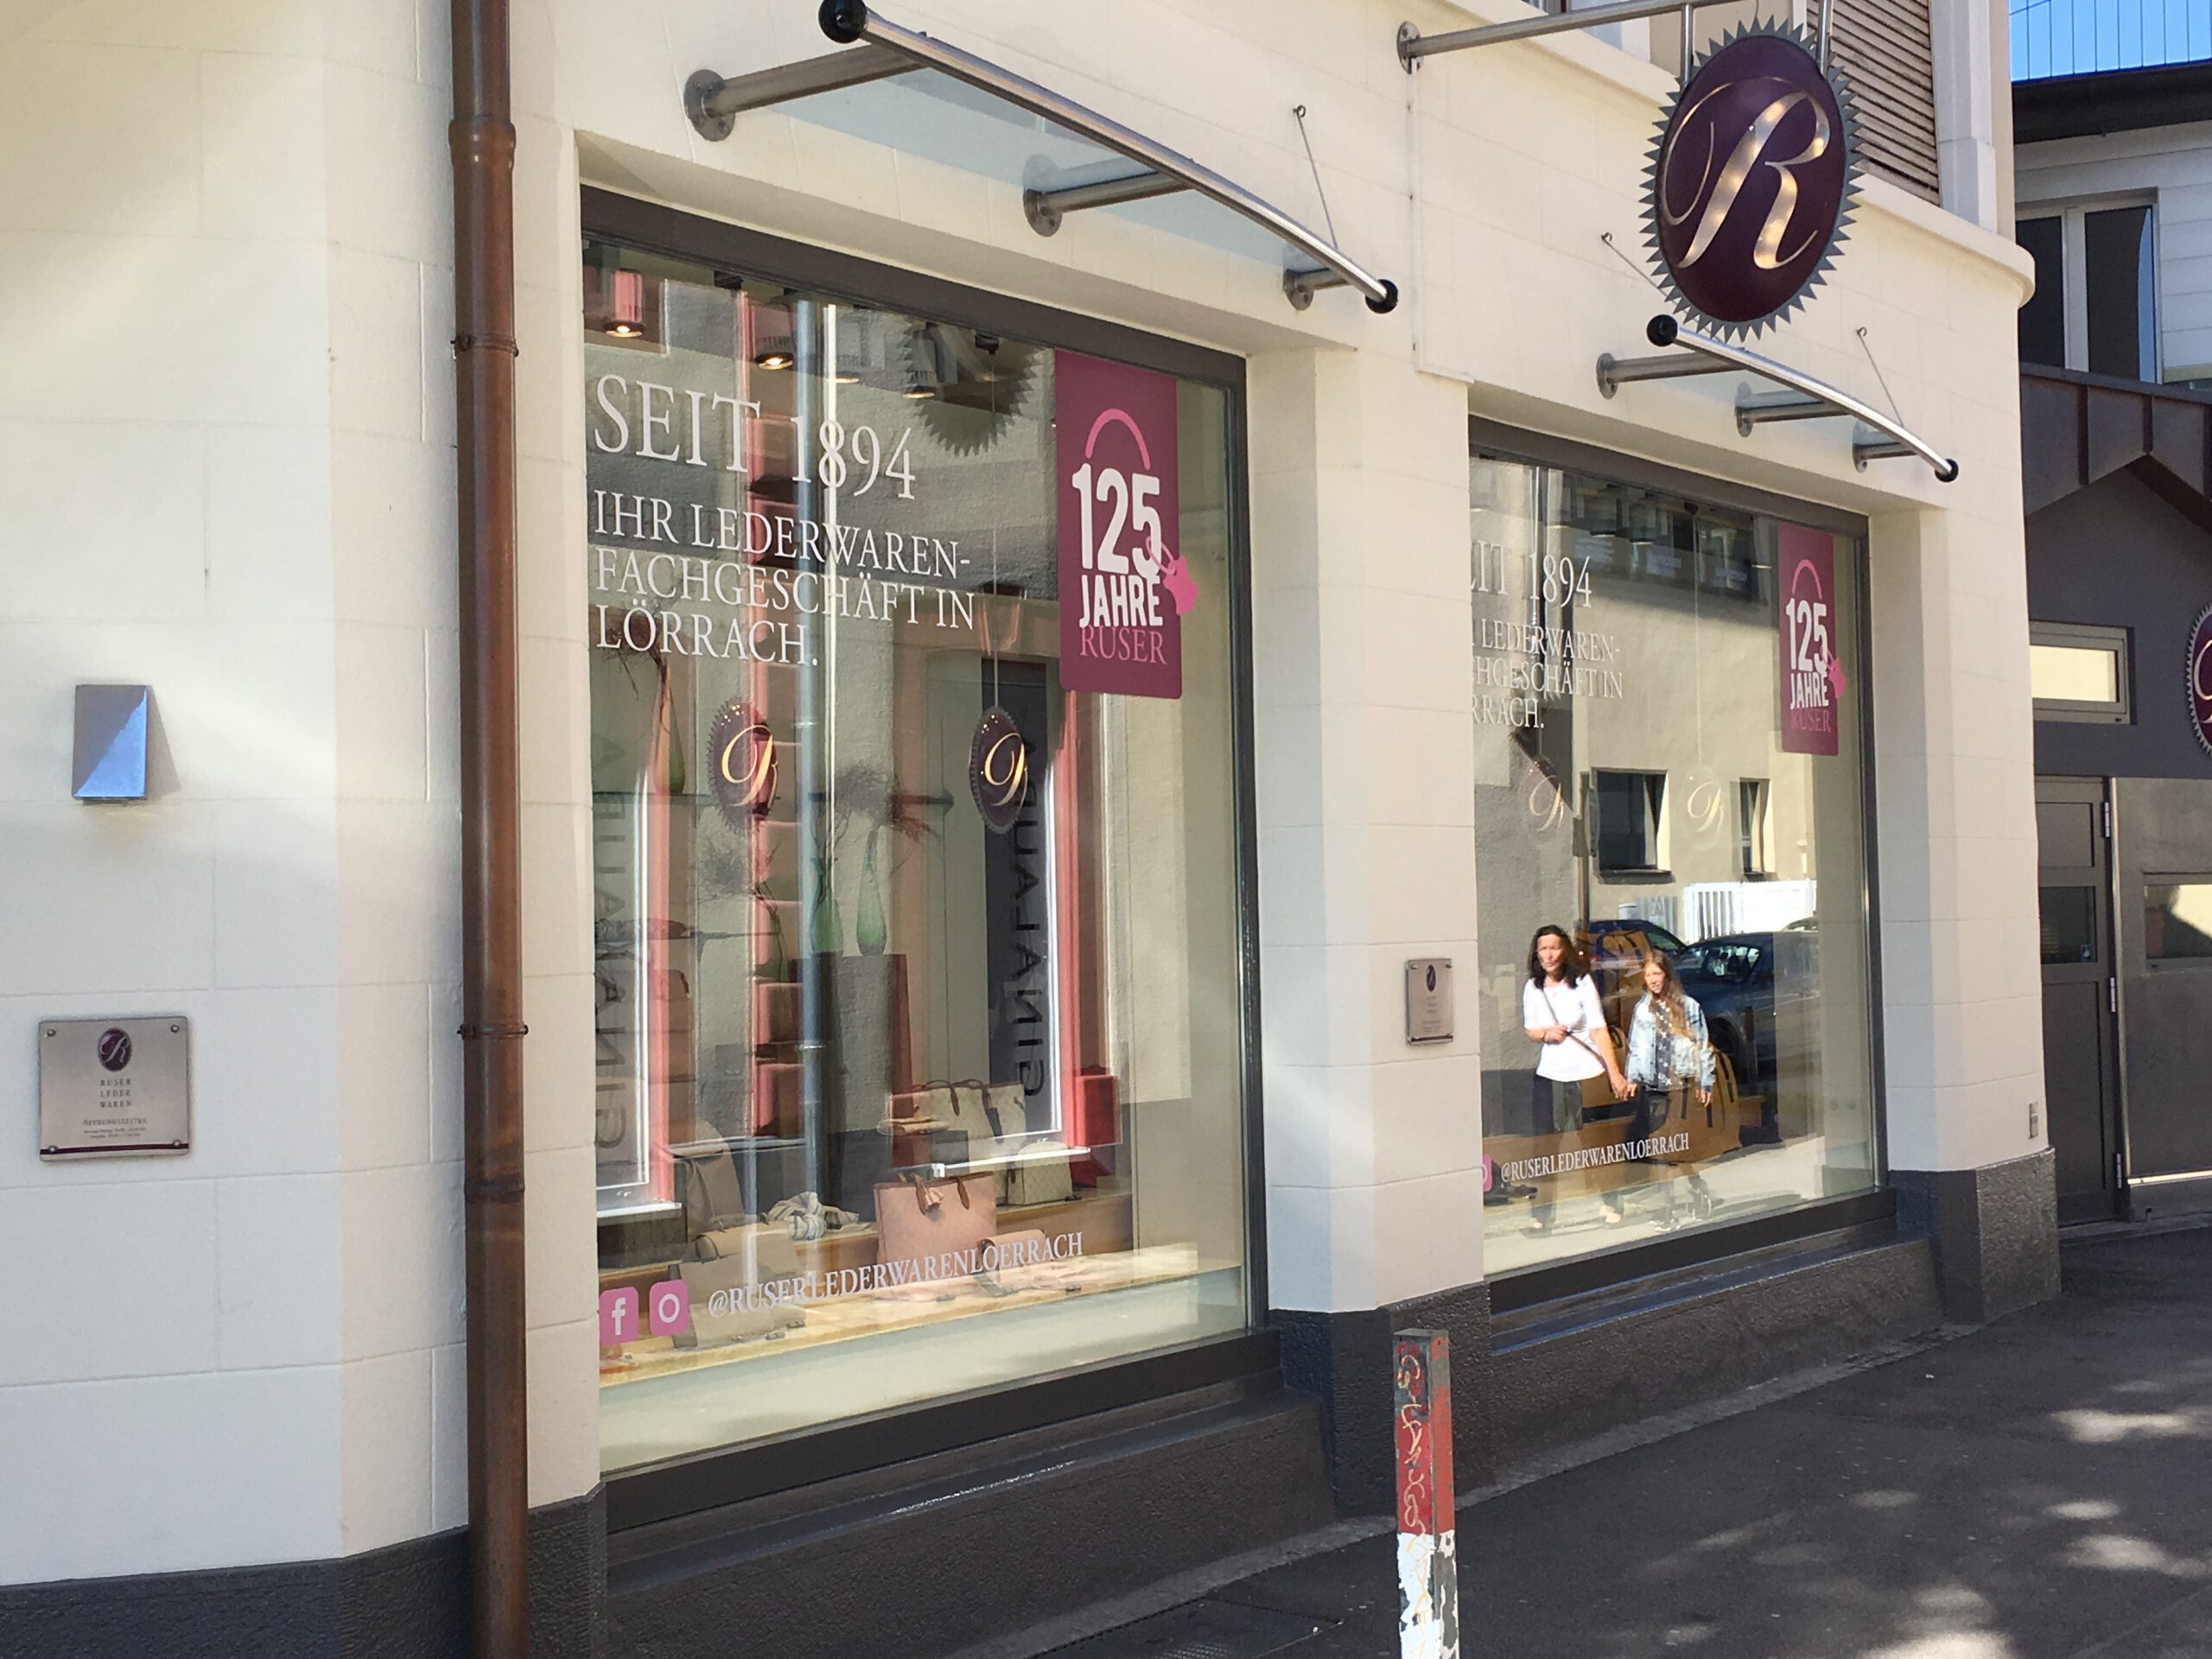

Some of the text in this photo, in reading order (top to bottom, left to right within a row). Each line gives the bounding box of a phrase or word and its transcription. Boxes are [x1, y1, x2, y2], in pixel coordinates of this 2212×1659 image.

[594, 374, 916, 500] SEIT 1894
[594, 489, 970, 580] IHR LEDERWAREN-
[1071, 463, 1162, 580] 125
[595, 546, 975, 631] FACHGESCHÄFT IN
[1078, 574, 1163, 628] JAHRE
[1529, 551, 1592, 608] 1894
[596, 598, 818, 666] LÖRRACH.
[1080, 624, 1166, 664] RUSER
[1481, 619, 1621, 663] LEDERWAREN-
[1785, 598, 1827, 675] 125
[1471, 694, 1544, 728] RRACH.
[1603, 671, 1623, 699] IN
[1790, 671, 1829, 709] JAHRE
[1789, 709, 1831, 733] RUSER
[1501, 1133, 1689, 1183] @RUSERLEDERWARENLOERRACH
[708, 1231, 1084, 1319] @RUSERLEDERWARENLOERRACH
